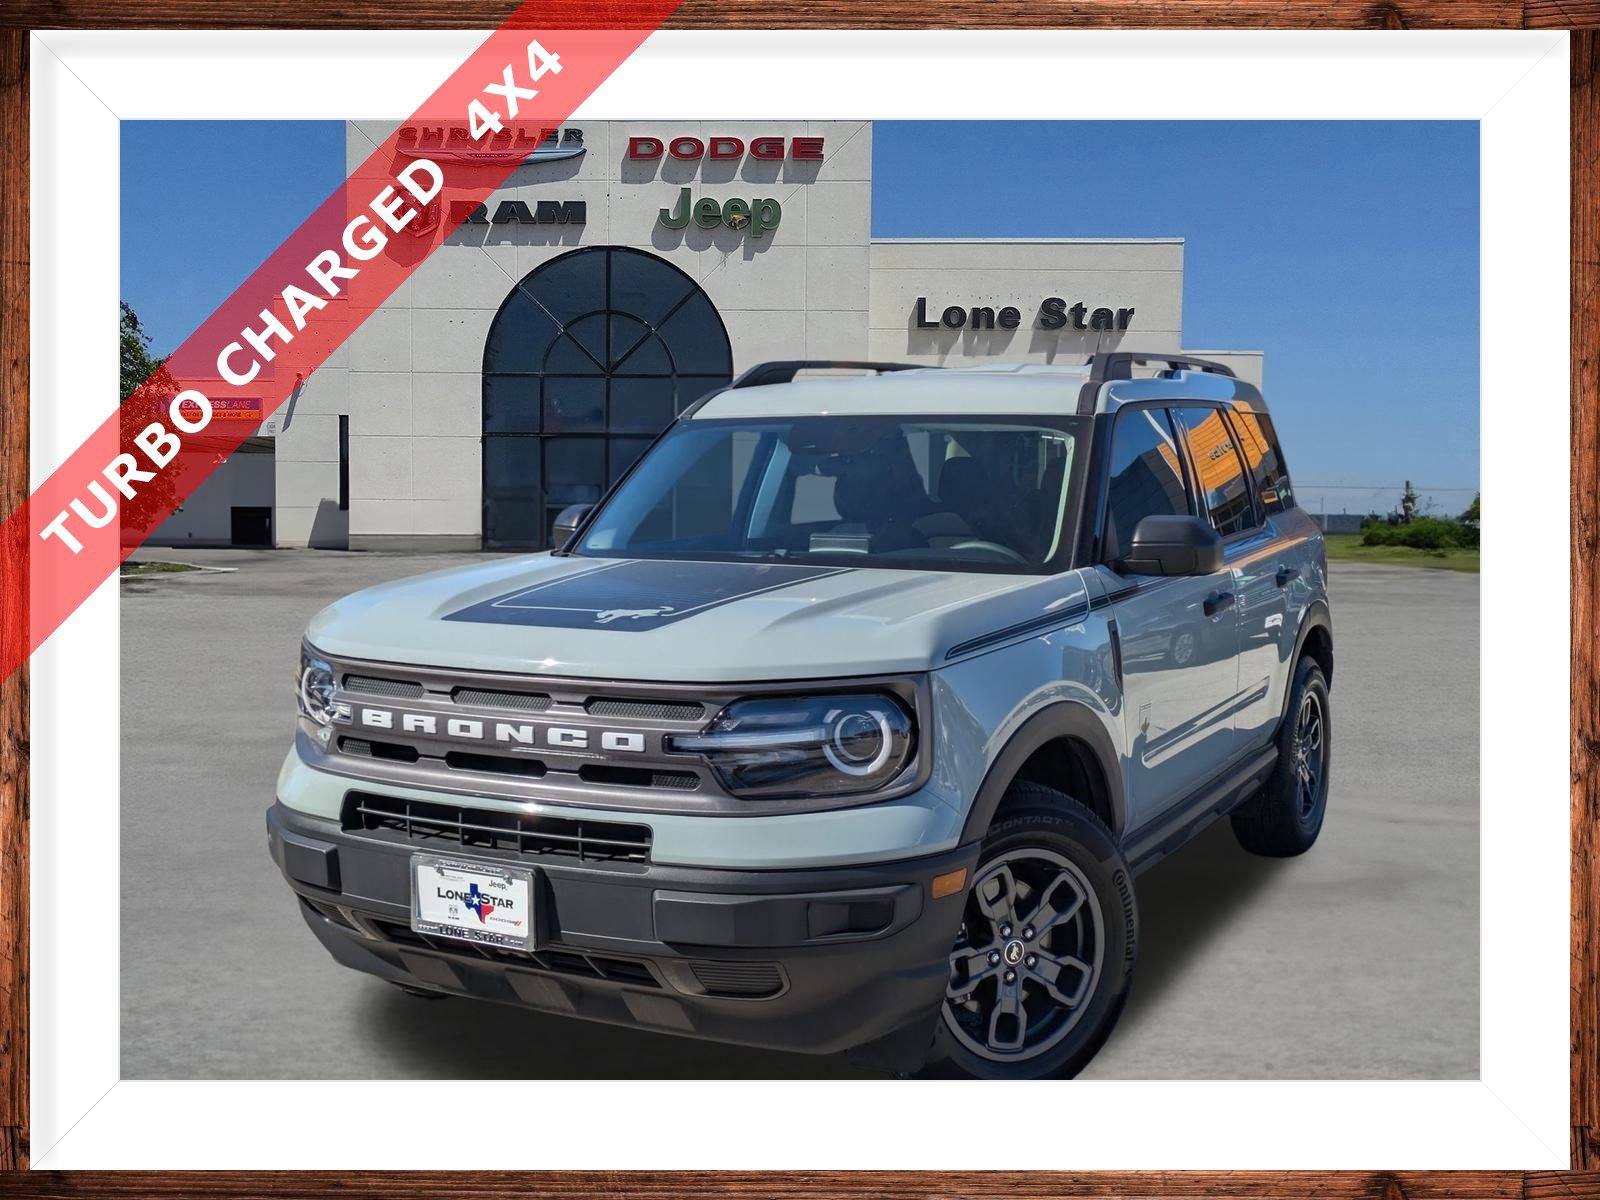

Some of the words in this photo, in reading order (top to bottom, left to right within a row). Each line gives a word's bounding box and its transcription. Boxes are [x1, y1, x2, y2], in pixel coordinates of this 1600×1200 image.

[399, 127, 584, 142] CHRSLER
[629, 136, 824, 162] DODGE
[452, 200, 586, 225] RAM
[659, 187, 782, 238] Jeep
[917, 297, 1021, 329] Lone
[1040, 297, 1135, 330] Star
[362, 708, 645, 752] BRONCO
[437, 887, 471, 905] LONE
[481, 892, 514, 909] STAR
[439, 926, 470, 939] LONE
[474, 931, 505, 945] STAR
